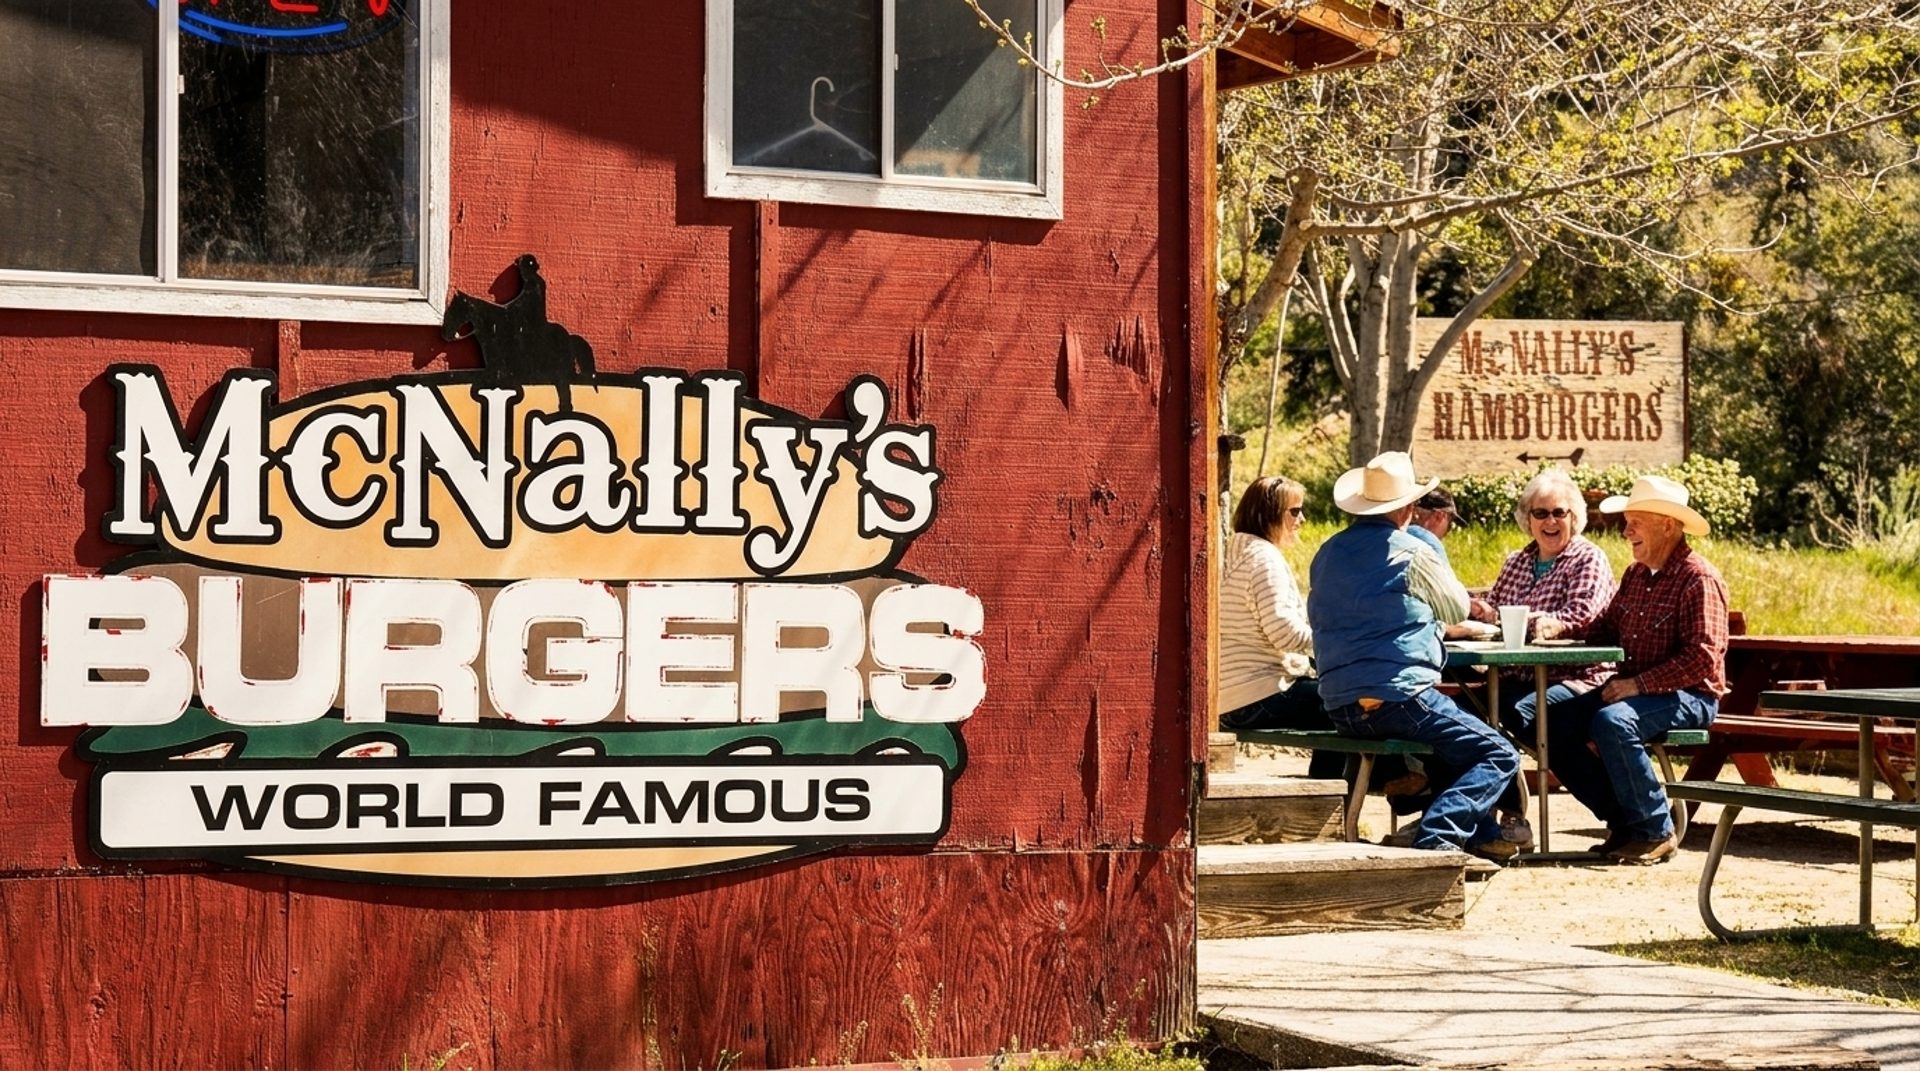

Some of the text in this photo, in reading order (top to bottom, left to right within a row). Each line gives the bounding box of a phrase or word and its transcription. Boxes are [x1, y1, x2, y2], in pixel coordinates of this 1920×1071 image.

[1432, 392, 1663, 441] HAMBURGERS
[110, 371, 939, 568] McNally's
[41, 575, 986, 727] BURGERS
[191, 779, 871, 831] WORLD FAMOUS
